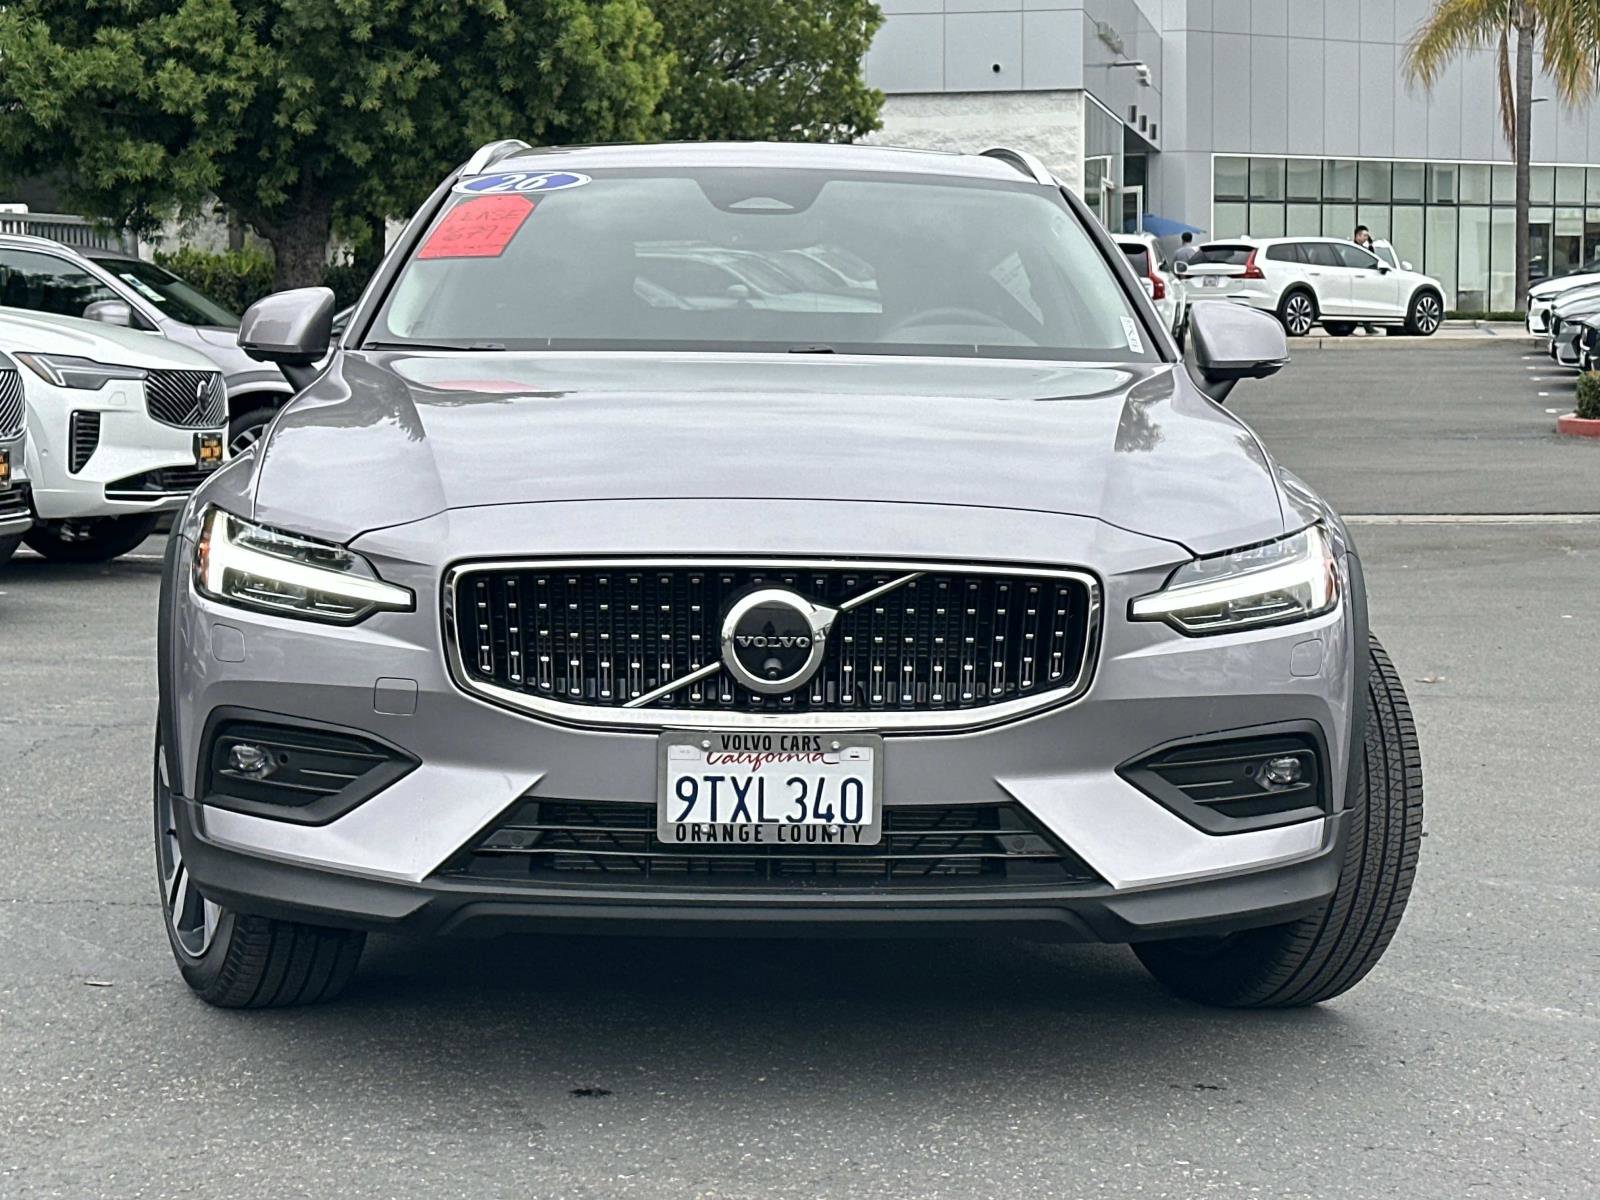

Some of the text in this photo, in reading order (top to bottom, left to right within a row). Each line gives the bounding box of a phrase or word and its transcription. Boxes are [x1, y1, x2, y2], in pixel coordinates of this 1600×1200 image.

[490, 173, 549, 190] 26
[735, 635, 811, 648] VOLVO
[721, 734, 821, 751] VOLVO CARS
[706, 750, 839, 772] California
[675, 775, 864, 824] 9TXL340
[675, 823, 864, 843] ORANGE COUNTY
